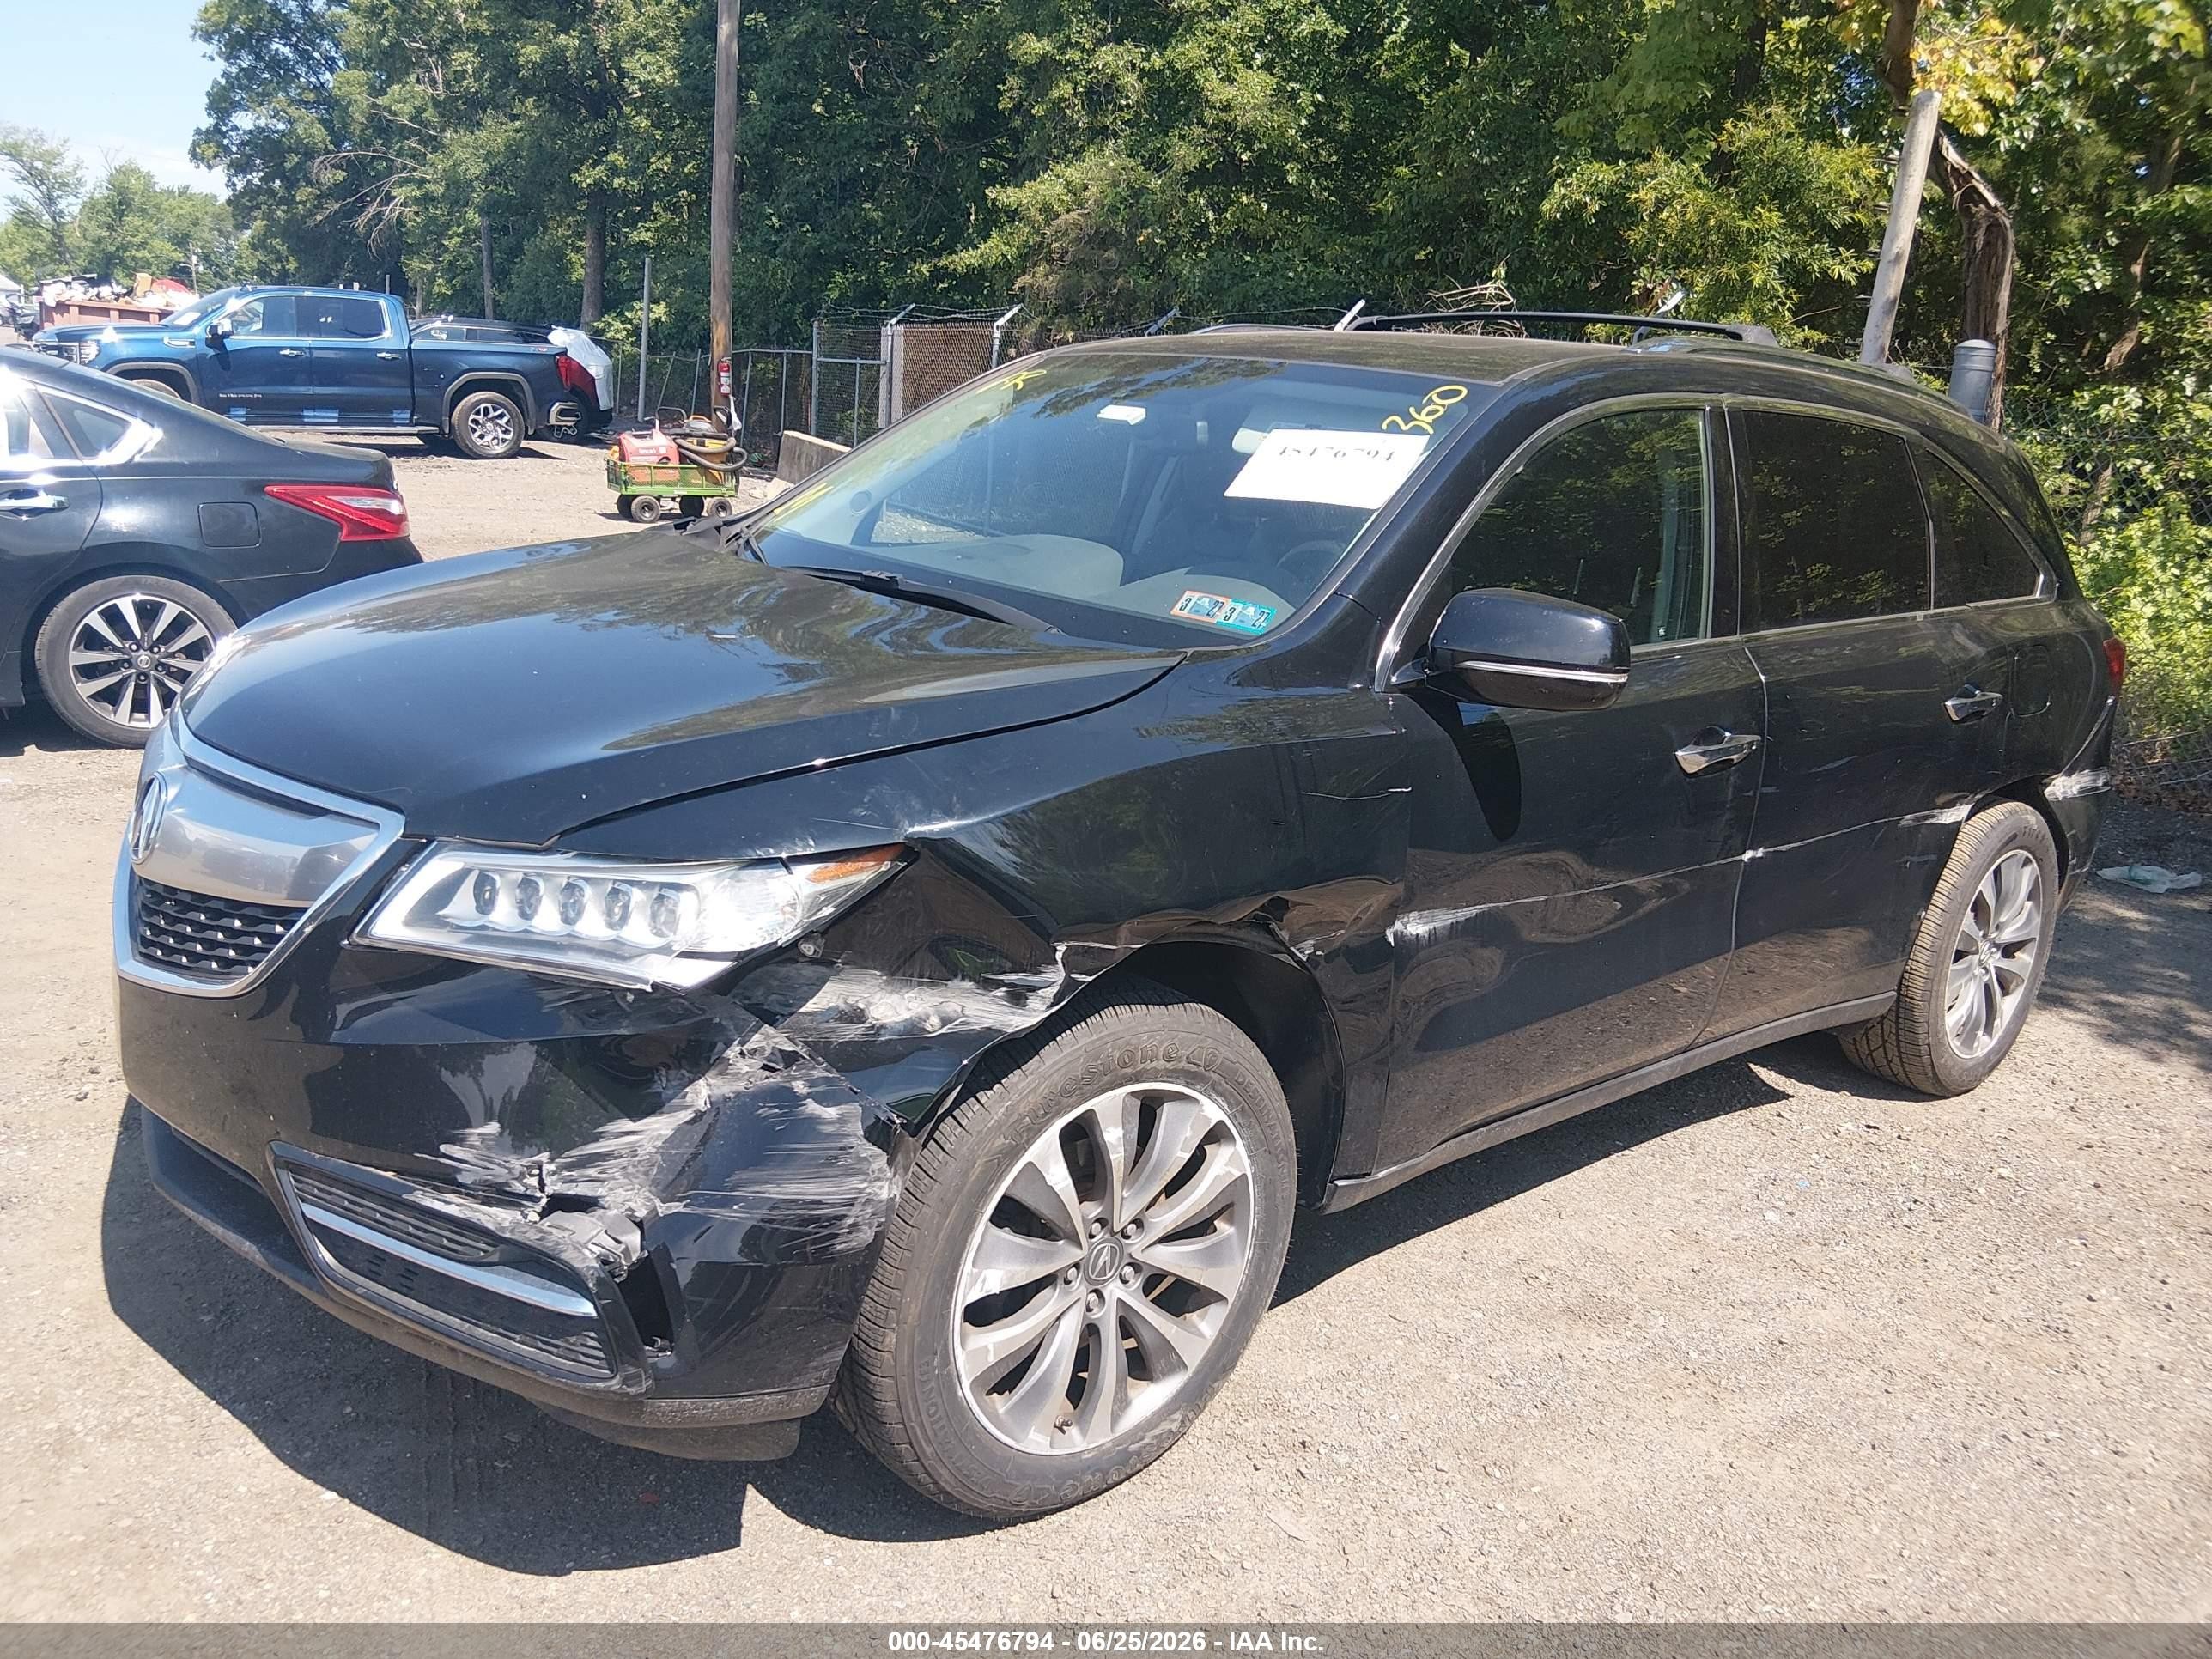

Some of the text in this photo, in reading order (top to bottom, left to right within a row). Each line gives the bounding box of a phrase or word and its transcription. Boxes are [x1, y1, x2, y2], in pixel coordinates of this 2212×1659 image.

[1381, 385, 1468, 434] 360
[1178, 597, 1224, 619] 3 27
[1223, 606, 1270, 629] 3 27
